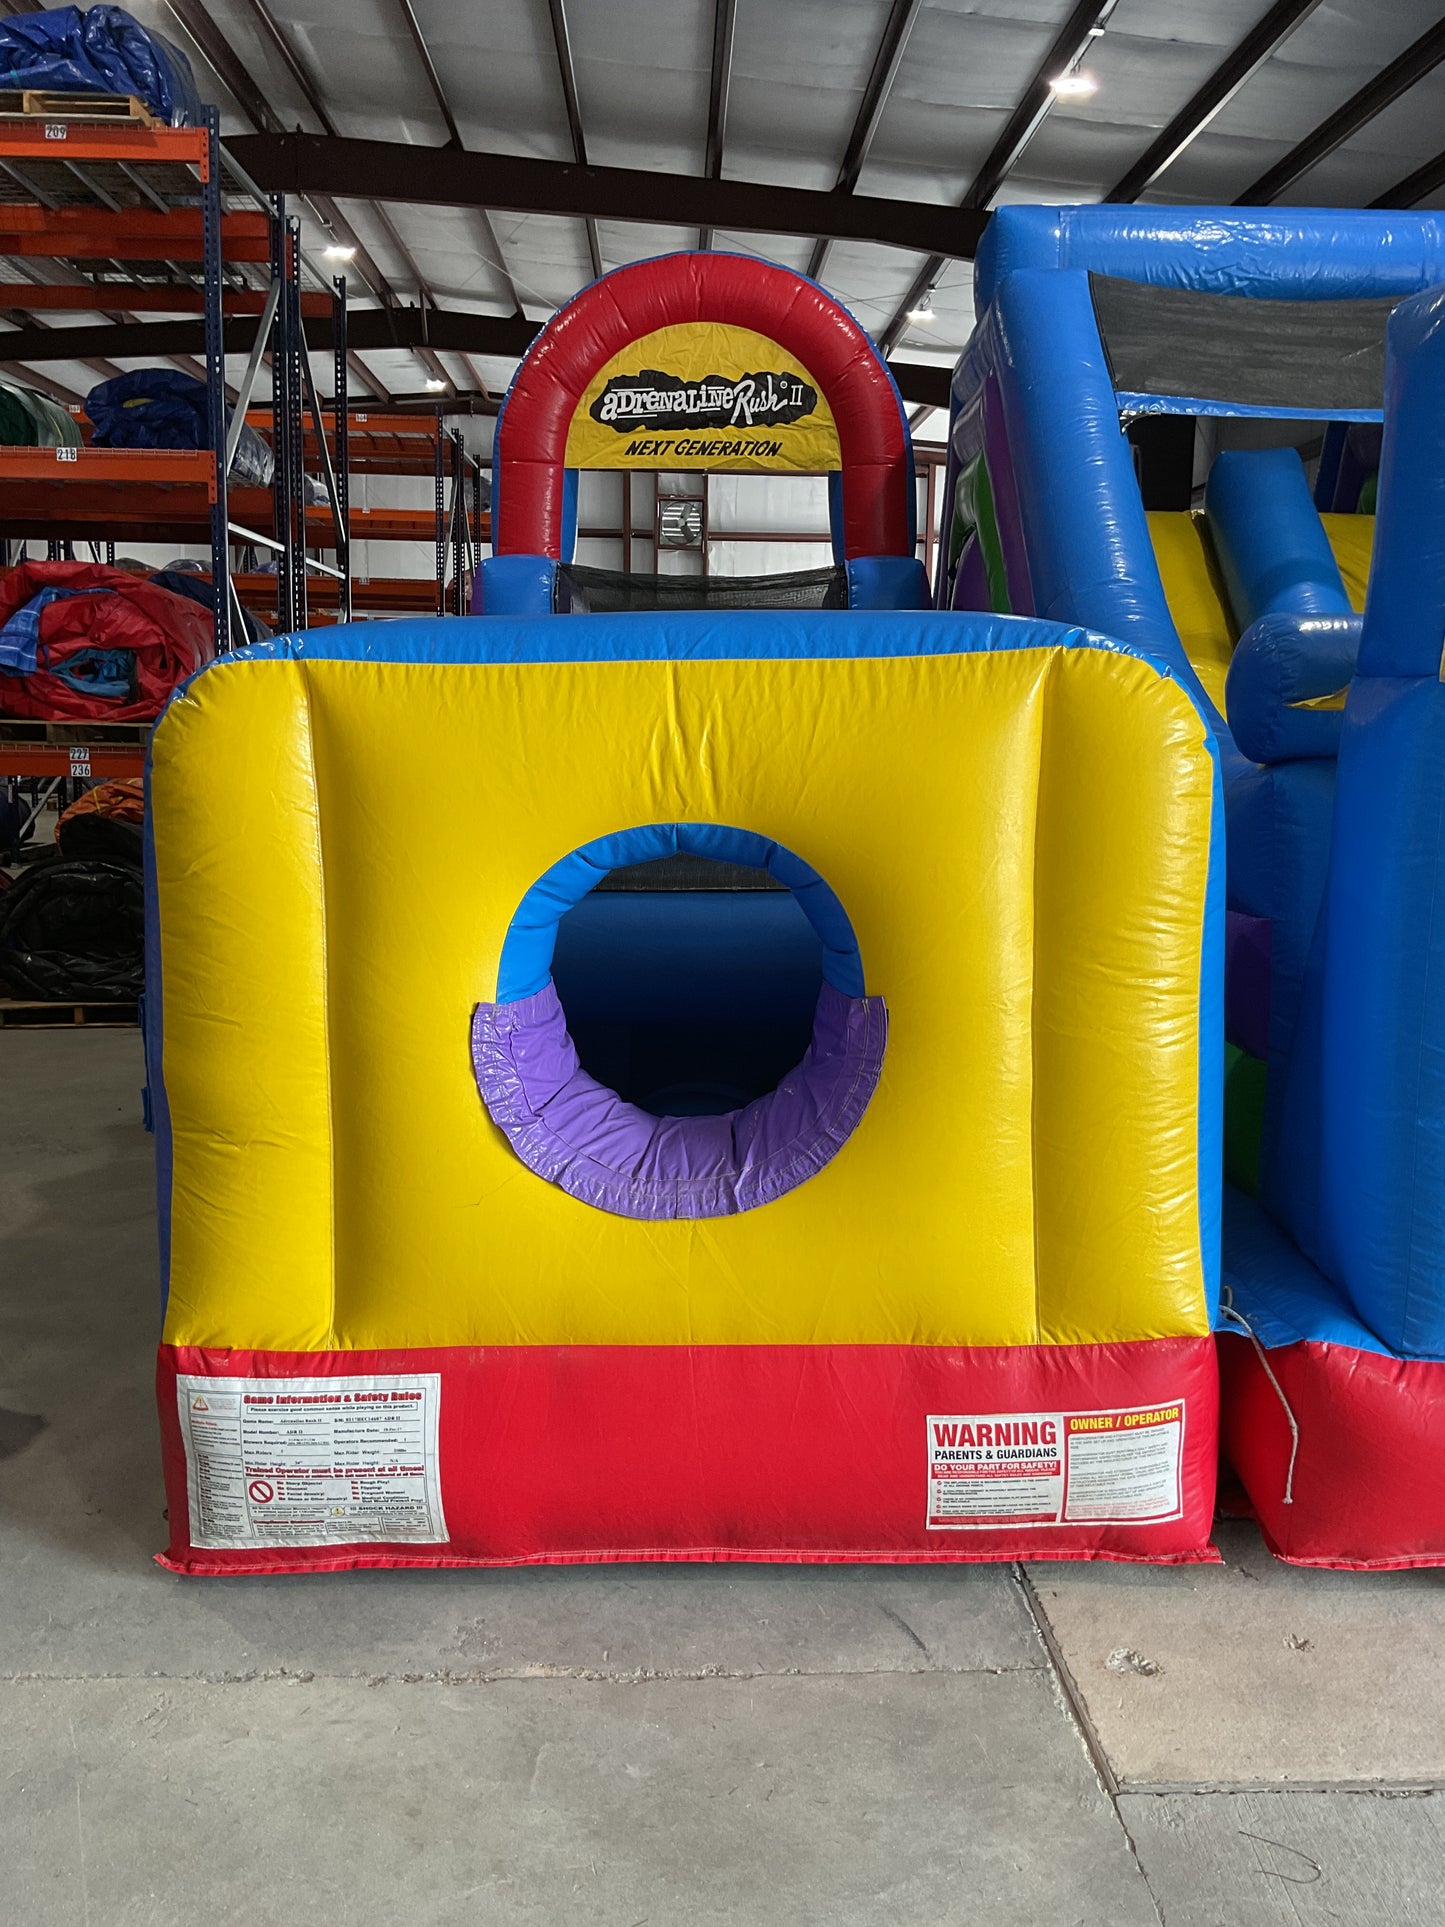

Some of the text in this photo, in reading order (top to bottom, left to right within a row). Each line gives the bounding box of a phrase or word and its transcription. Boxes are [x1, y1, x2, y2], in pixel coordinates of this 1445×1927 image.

[46, 126, 66, 138] 209
[730, 375, 789, 424] Rush
[790, 385, 804, 406] II
[624, 438, 783, 456] NEXT GENERATION
[58, 448, 76, 460] 218
[70, 748, 88, 760] 227
[72, 764, 89, 776] 236
[244, 1394, 274, 1404] Game
[276, 1394, 341, 1404] Information
[344, 1394, 352, 1402] &
[354, 1392, 389, 1402] Safety
[391, 1392, 422, 1401] Rules
[1070, 1408, 1179, 1430] OWNER / OPERATOR
[933, 1421, 1057, 1447] WARNING
[935, 1448, 1057, 1460] PARENTS & GUARDIANS
